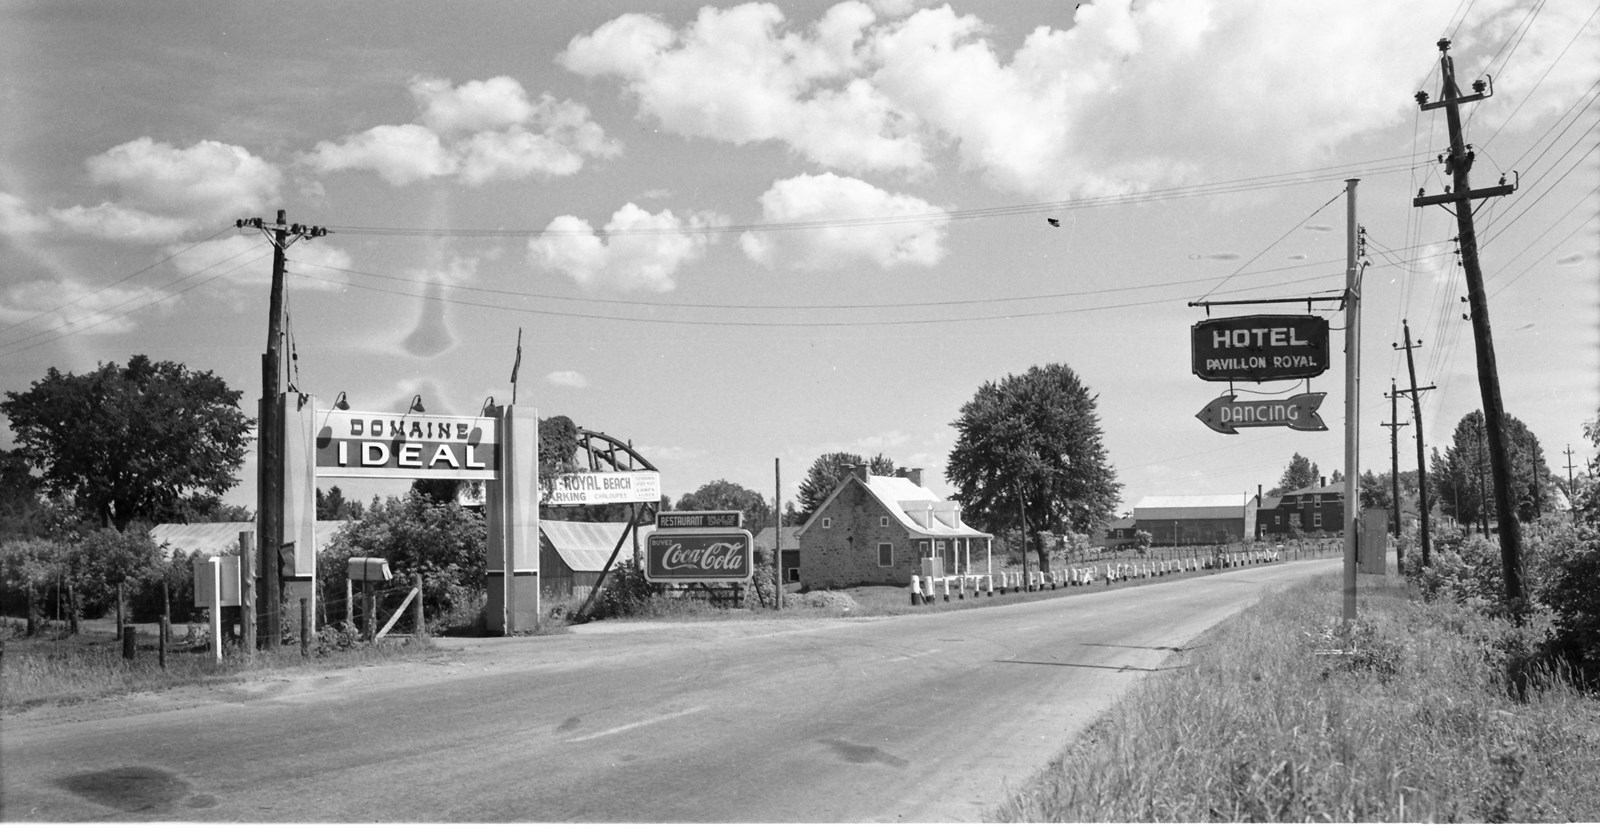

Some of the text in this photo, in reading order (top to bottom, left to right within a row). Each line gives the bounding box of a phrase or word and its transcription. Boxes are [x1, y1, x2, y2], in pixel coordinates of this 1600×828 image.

[1213, 327, 1308, 348] HOTEL
[1206, 356, 1317, 370] PAVILLON ROYAL
[1221, 405, 1298, 422] DANCING
[351, 419, 468, 439] DOMAINE
[338, 441, 486, 468] IDEAL
[603, 477, 631, 490] BEACH
[660, 515, 704, 527] RESTAURANT
[662, 542, 744, 570] Coca-Cola
